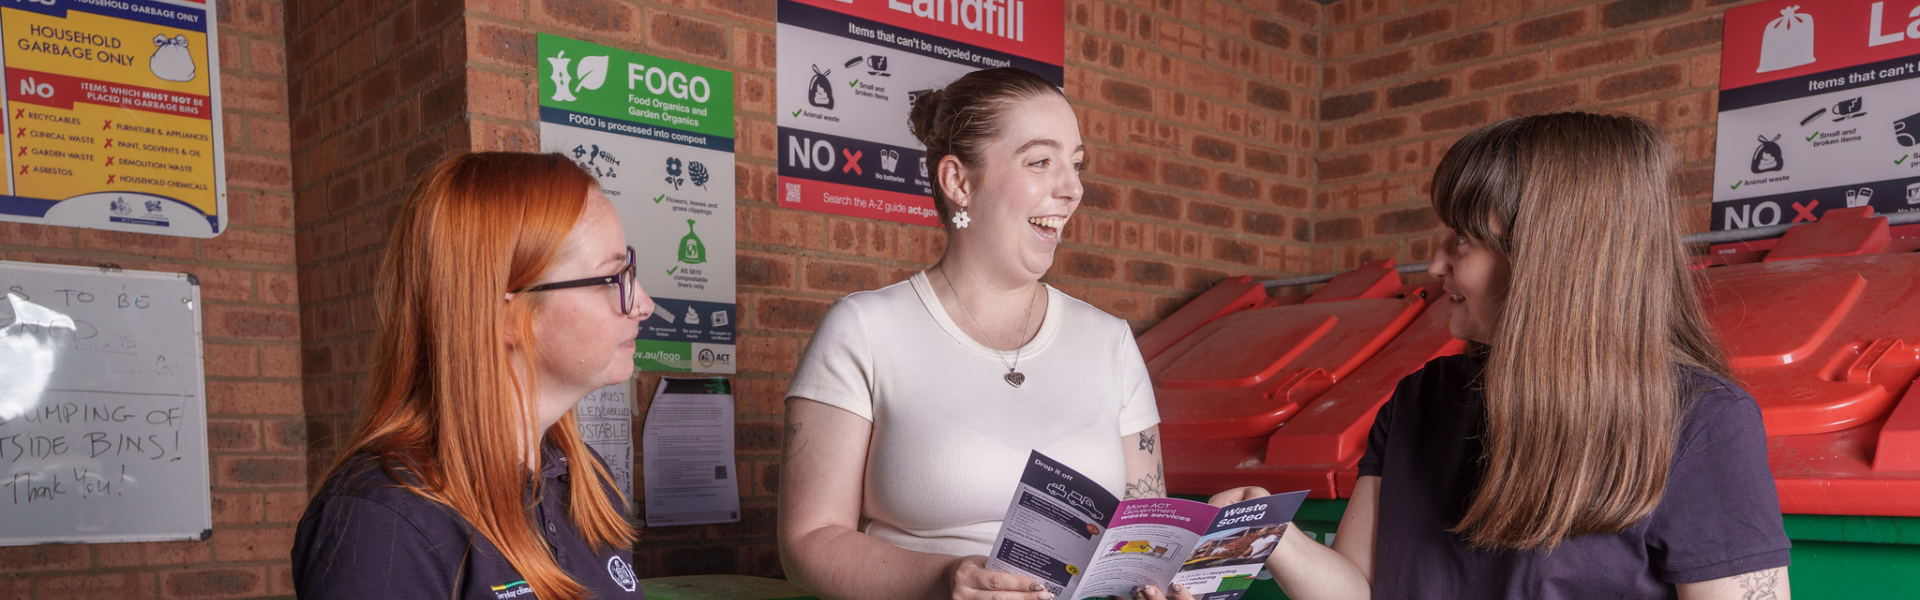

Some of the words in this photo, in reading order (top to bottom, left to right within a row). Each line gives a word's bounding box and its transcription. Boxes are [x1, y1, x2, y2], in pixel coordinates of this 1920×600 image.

[74, 0, 129, 10] USEHOLD
[131, 4, 175, 18] GARBAGE
[176, 12, 199, 23] ONLY
[30, 24, 121, 49] HOUSEHOLD
[18, 38, 92, 60] GARBAGE
[97, 51, 135, 66] ONLY
[848, 22, 875, 38] Items
[877, 30, 895, 43] that
[897, 35, 919, 49] can't
[920, 39, 932, 52] be
[934, 44, 970, 60] recycled
[971, 54, 981, 63] or
[982, 57, 1010, 68] reused
[628, 62, 711, 103] FOGO
[1808, 77, 1845, 91] Items
[1848, 70, 1876, 83] that
[1879, 63, 1914, 78] can't
[859, 82, 874, 90] Small
[81, 82, 107, 93] ITEMS
[110, 86, 140, 97] WHICH
[142, 91, 169, 101] MUST
[171, 95, 191, 104] NOT
[193, 99, 203, 107] BE
[855, 89, 873, 97] broken
[875, 92, 889, 101] items
[87, 92, 120, 103] PLACED
[122, 97, 132, 105] IN
[134, 98, 178, 111] GARBAGE
[179, 104, 199, 114] BINS
[628, 94, 650, 106] Food
[652, 98, 690, 114] Organics
[692, 106, 707, 117] and
[28, 112, 81, 125] RECYCLABLES
[628, 106, 660, 120] Garden
[662, 112, 699, 127] Organics
[803, 110, 822, 120] Animal
[823, 114, 840, 123] waste
[30, 130, 65, 141] CLINICAL
[68, 134, 94, 144] WASTE
[116, 123, 155, 135] FURNITURE
[166, 130, 209, 141] APPLIANCES
[569, 113, 596, 127] FOGO
[598, 118, 606, 128] is
[607, 121, 652, 136] processed
[654, 128, 669, 139] into
[671, 132, 707, 145] compost
[1820, 130, 1840, 139] Small
[118, 141, 141, 151] PAINT,
[142, 143, 179, 155] SOLVENTS
[189, 149, 201, 157] OIL
[1813, 138, 1839, 147] broken
[1841, 135, 1861, 143] items
[31, 148, 66, 157] GARDEN
[68, 152, 94, 161] WASTE
[788, 135, 836, 172] NO
[33, 166, 73, 176] ASBESTOS
[119, 158, 166, 170] DEMOLITION
[168, 164, 193, 173] WASTE
[120, 175, 166, 187] HOUSEHOLD
[167, 180, 208, 191] CHEMICALS
[884, 173, 905, 183] batteries
[1743, 177, 1767, 186] Animal
[1768, 175, 1790, 183] waste
[688, 207, 712, 215] clippings
[690, 199, 706, 207] leaves
[823, 192, 851, 205] Search
[853, 197, 867, 207] the
[868, 199, 884, 210] A-Z
[885, 201, 906, 214] guide
[1724, 201, 1782, 230] NO
[674, 274, 708, 283] compostable
[693, 283, 704, 291] only
[54, 289, 95, 307] TO
[117, 293, 150, 309] BE
[601, 391, 625, 403] MUST
[146, 407, 181, 426] OF
[83, 430, 182, 462] BINS!
[1034, 459, 1054, 473] Drop
[1054, 468, 1061, 476] it
[1061, 473, 1073, 481] off
[5, 473, 66, 504] Thank
[1121, 512, 1149, 520] waste
[1150, 513, 1191, 522] services
[1224, 503, 1268, 518] Waste
[1216, 511, 1266, 528] Sorted
